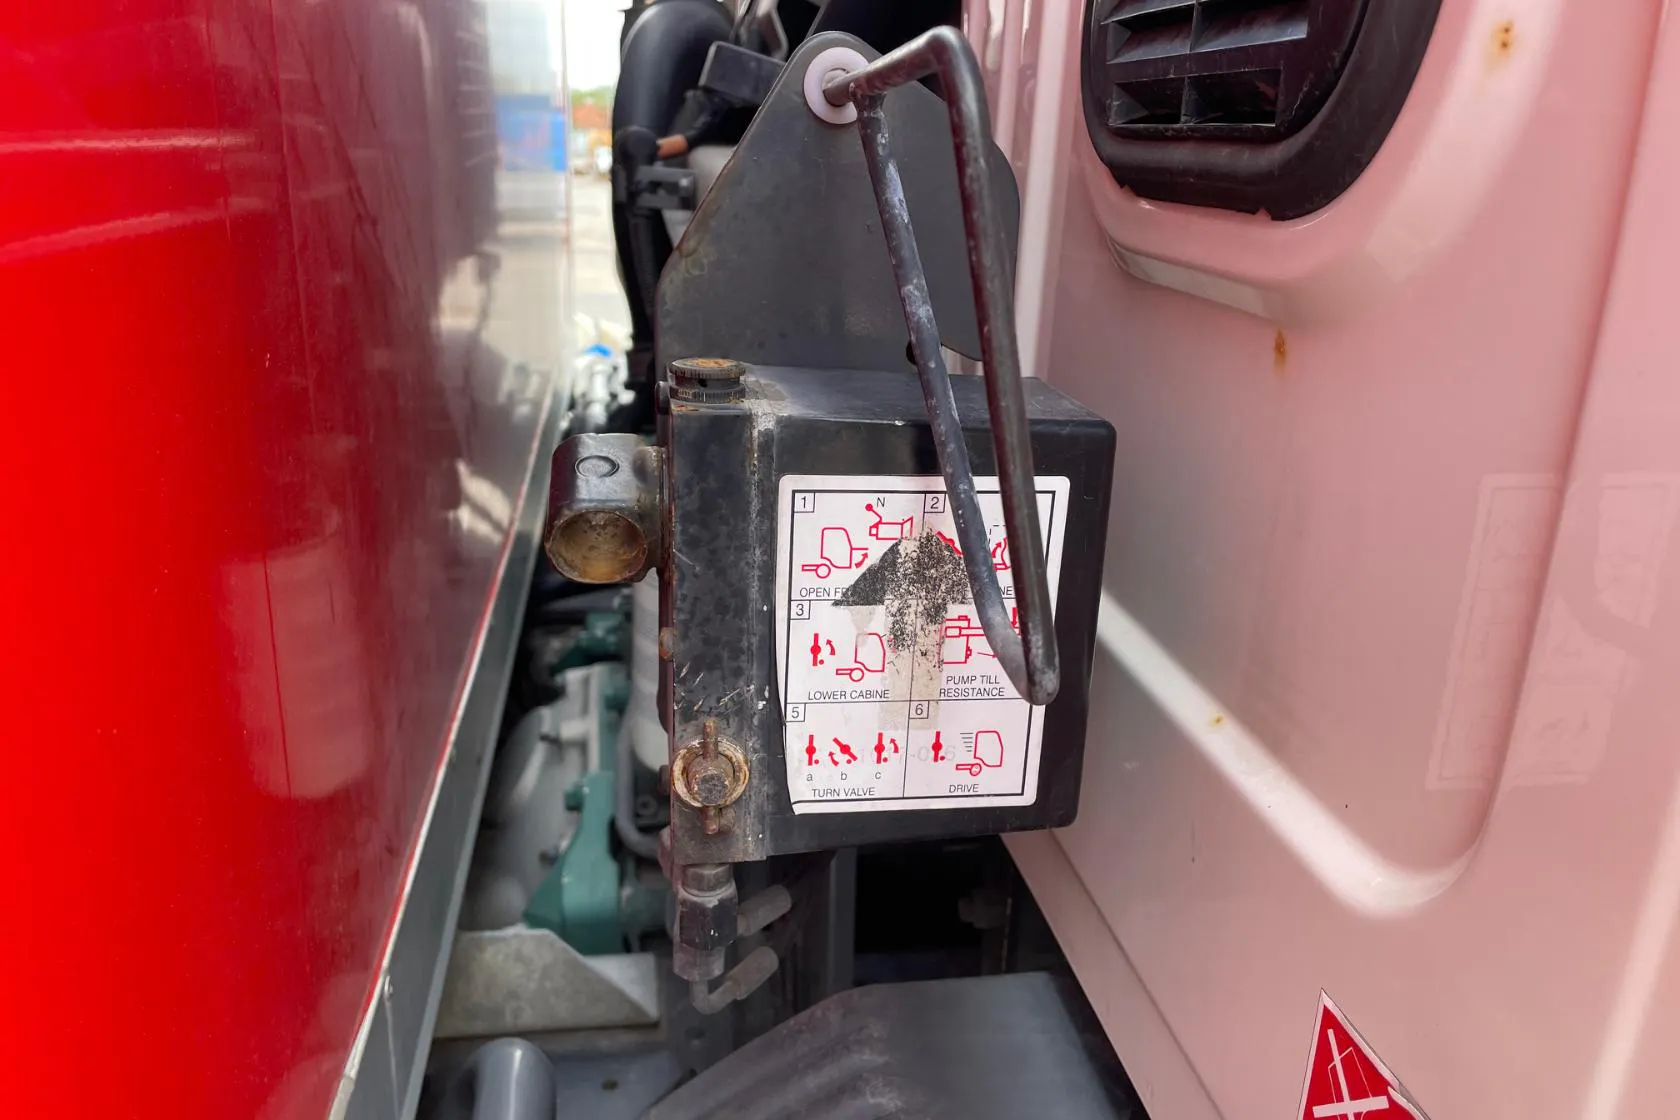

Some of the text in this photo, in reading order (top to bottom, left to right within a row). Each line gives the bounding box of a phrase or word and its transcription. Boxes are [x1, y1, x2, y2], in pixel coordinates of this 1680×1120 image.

[801, 496, 807, 509] 1
[876, 497, 886, 508] N
[930, 496, 940, 510] 2
[799, 587, 831, 598] OPEN
[795, 603, 805, 617] 3
[945, 674, 1001, 685] PUMP TILL
[807, 689, 890, 701] LOWER CABINE
[939, 686, 1005, 698] RESISTANCE
[791, 706, 800, 719] 5
[914, 703, 924, 716] 6
[806, 771, 882, 782] a b c
[811, 786, 875, 798] TURN VALVE
[948, 783, 979, 794] DRIVE
